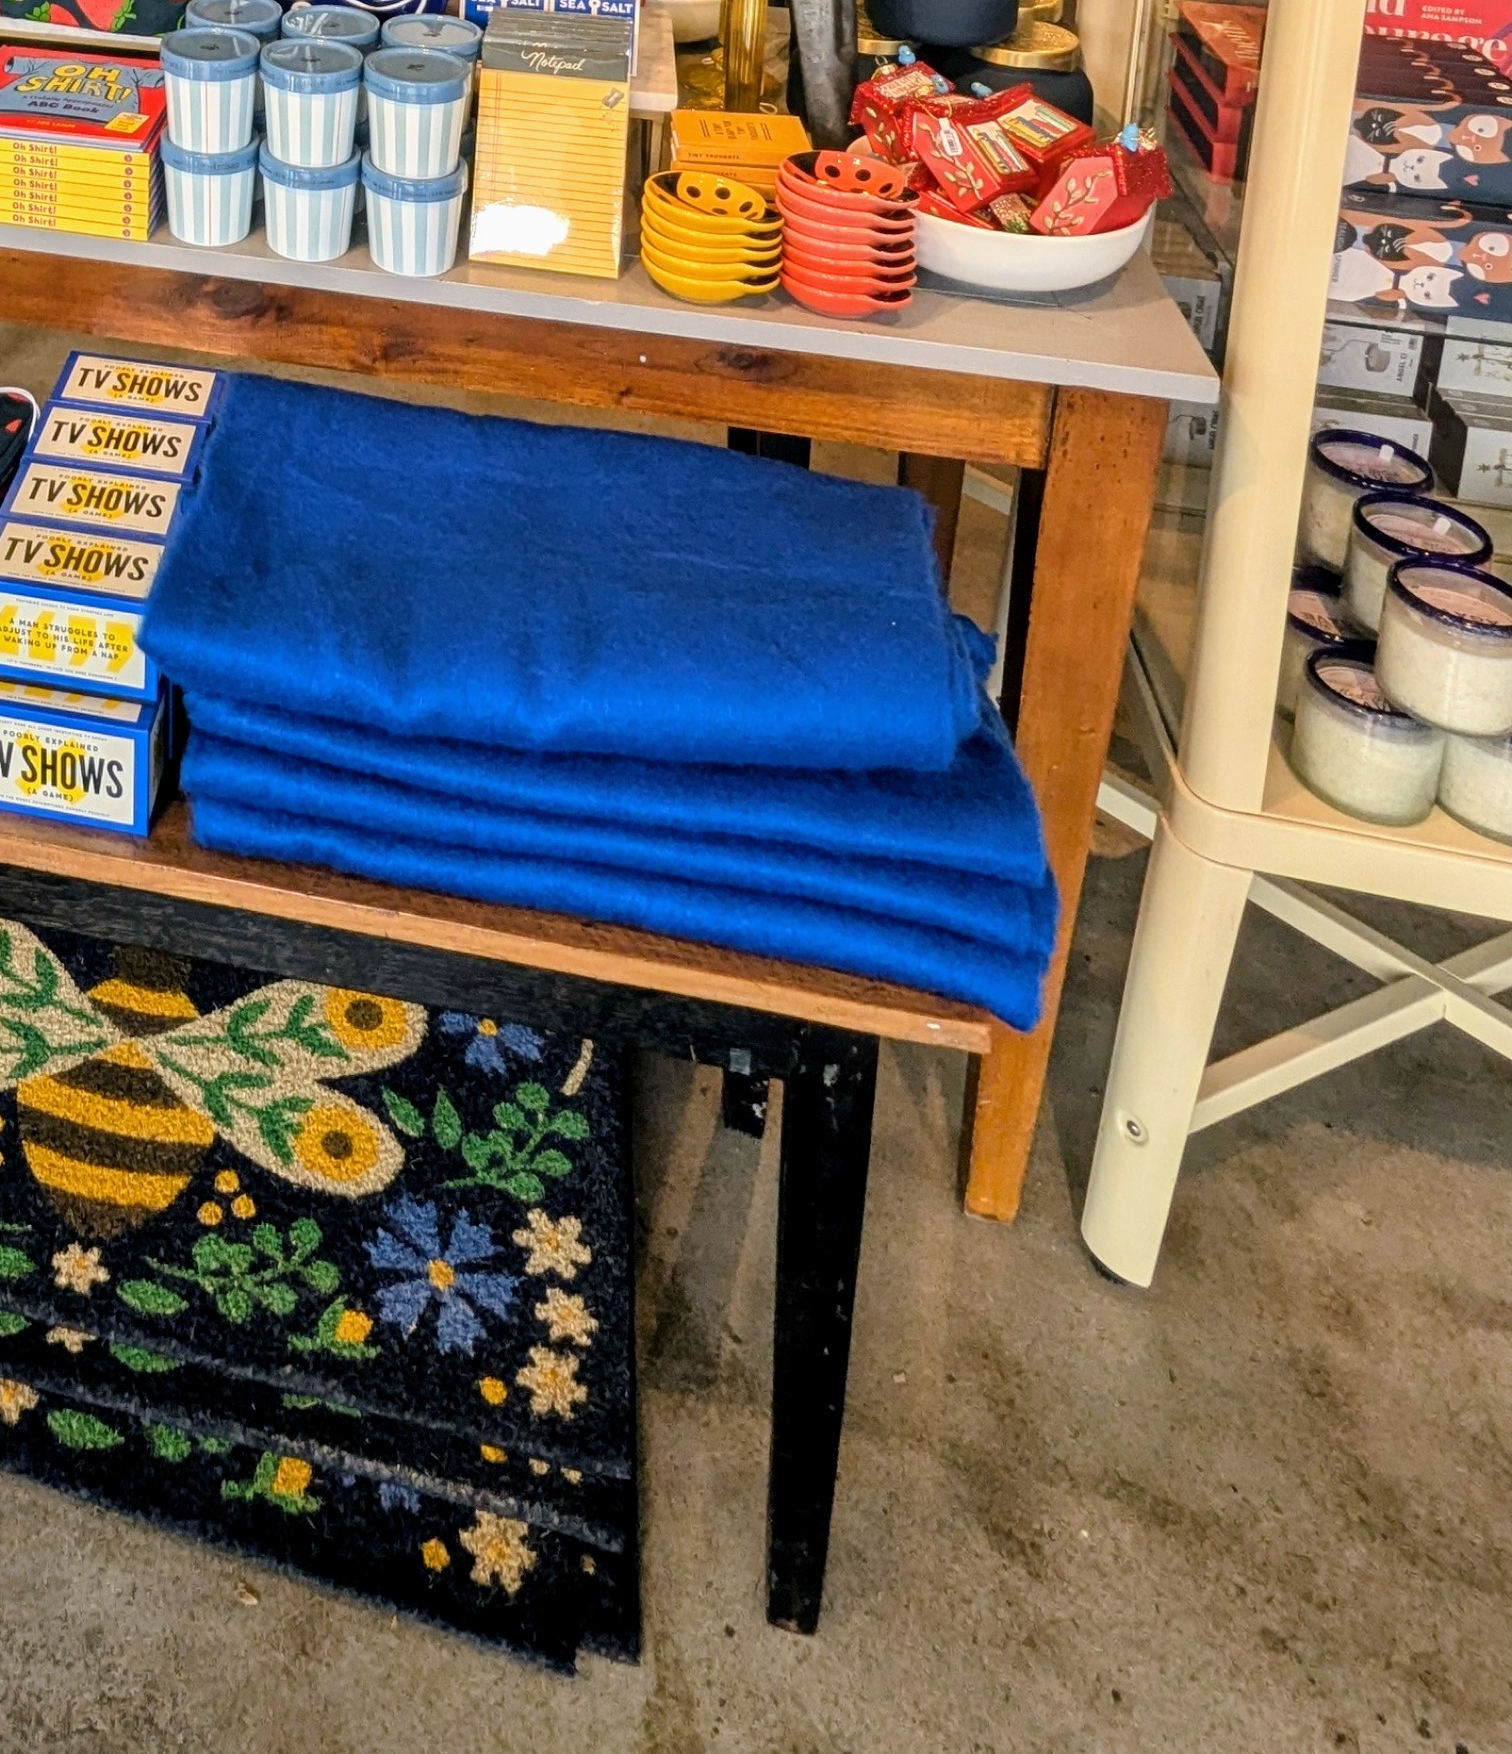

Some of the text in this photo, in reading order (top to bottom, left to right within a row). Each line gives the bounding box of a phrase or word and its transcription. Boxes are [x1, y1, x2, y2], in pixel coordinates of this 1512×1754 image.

[601, 1, 634, 14] SALT
[1421, 5, 1465, 15] EDITED BY
[1441, 14, 1483, 25] SAMPSON
[522, 50, 585, 74] Notepad
[53, 64, 121, 82] OH
[14, 75, 132, 104] SHIRT!
[28, 100, 99, 114] ABC Book
[12, 141, 57, 154] Oh Shirt!
[14, 154, 58, 166] Oh Shirt!
[29, 168, 57, 179] Shirt!
[29, 180, 57, 191] Shirt!
[14, 190, 57, 202] Oh Shirt!
[13, 202, 56, 214] Oh Shirt!
[13, 214, 56, 226] Oh Shirt!
[78, 367, 203, 402] TV SHOWS
[51, 420, 182, 458] TV SHOWS
[29, 477, 167, 518] TV SHOWS
[4, 537, 149, 581] TV SHOWS
[8, 617, 115, 641] A MAN STRUGGLES TO
[4, 635, 41, 647] WAKING
[45, 641, 57, 650] UP
[61, 644, 88, 655] FROM
[101, 652, 121, 661] NAP.
[37, 631, 49, 639] TO
[53, 633, 69, 642] HIS
[73, 637, 94, 647] LIFE
[98, 641, 128, 652] AFTER
[3, 729, 40, 742] POORLY
[45, 736, 99, 752] EXPLAINED
[21, 744, 124, 799] SHOWS
[27, 787, 74, 803] (A GAME)
